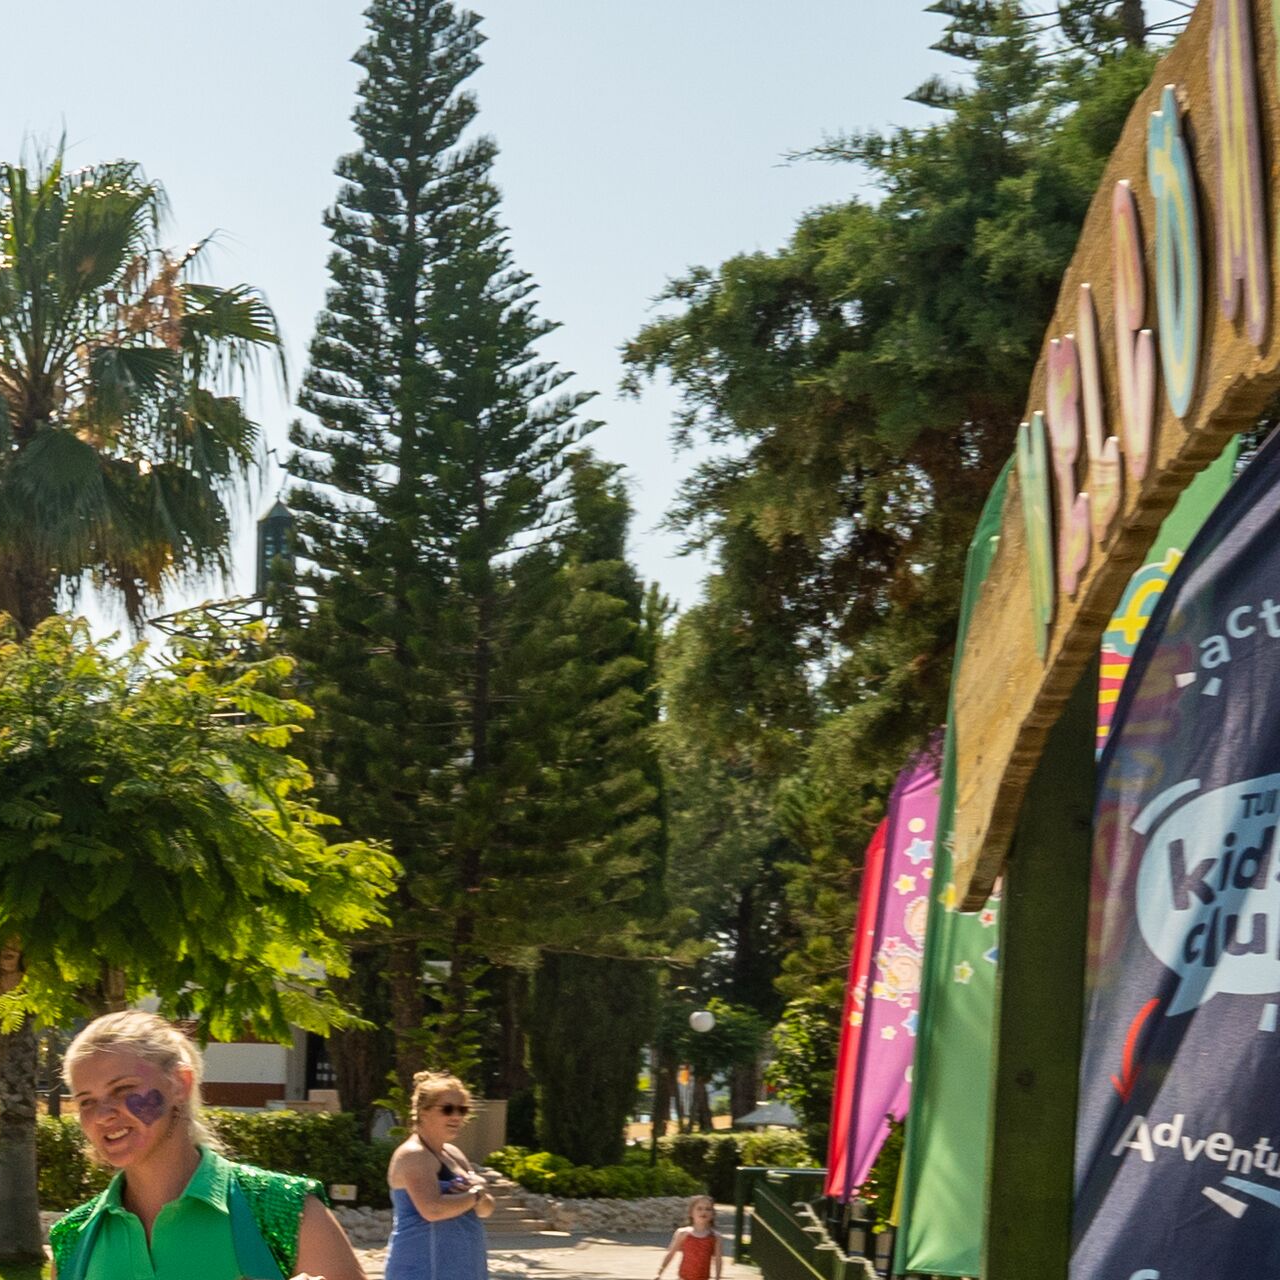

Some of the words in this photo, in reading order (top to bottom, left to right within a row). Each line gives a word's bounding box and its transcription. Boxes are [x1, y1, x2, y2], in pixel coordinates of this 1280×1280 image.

[1016, 0, 1280, 662] WELCOM
[1168, 824, 1280, 911] kid
[1184, 906, 1280, 968] clu
